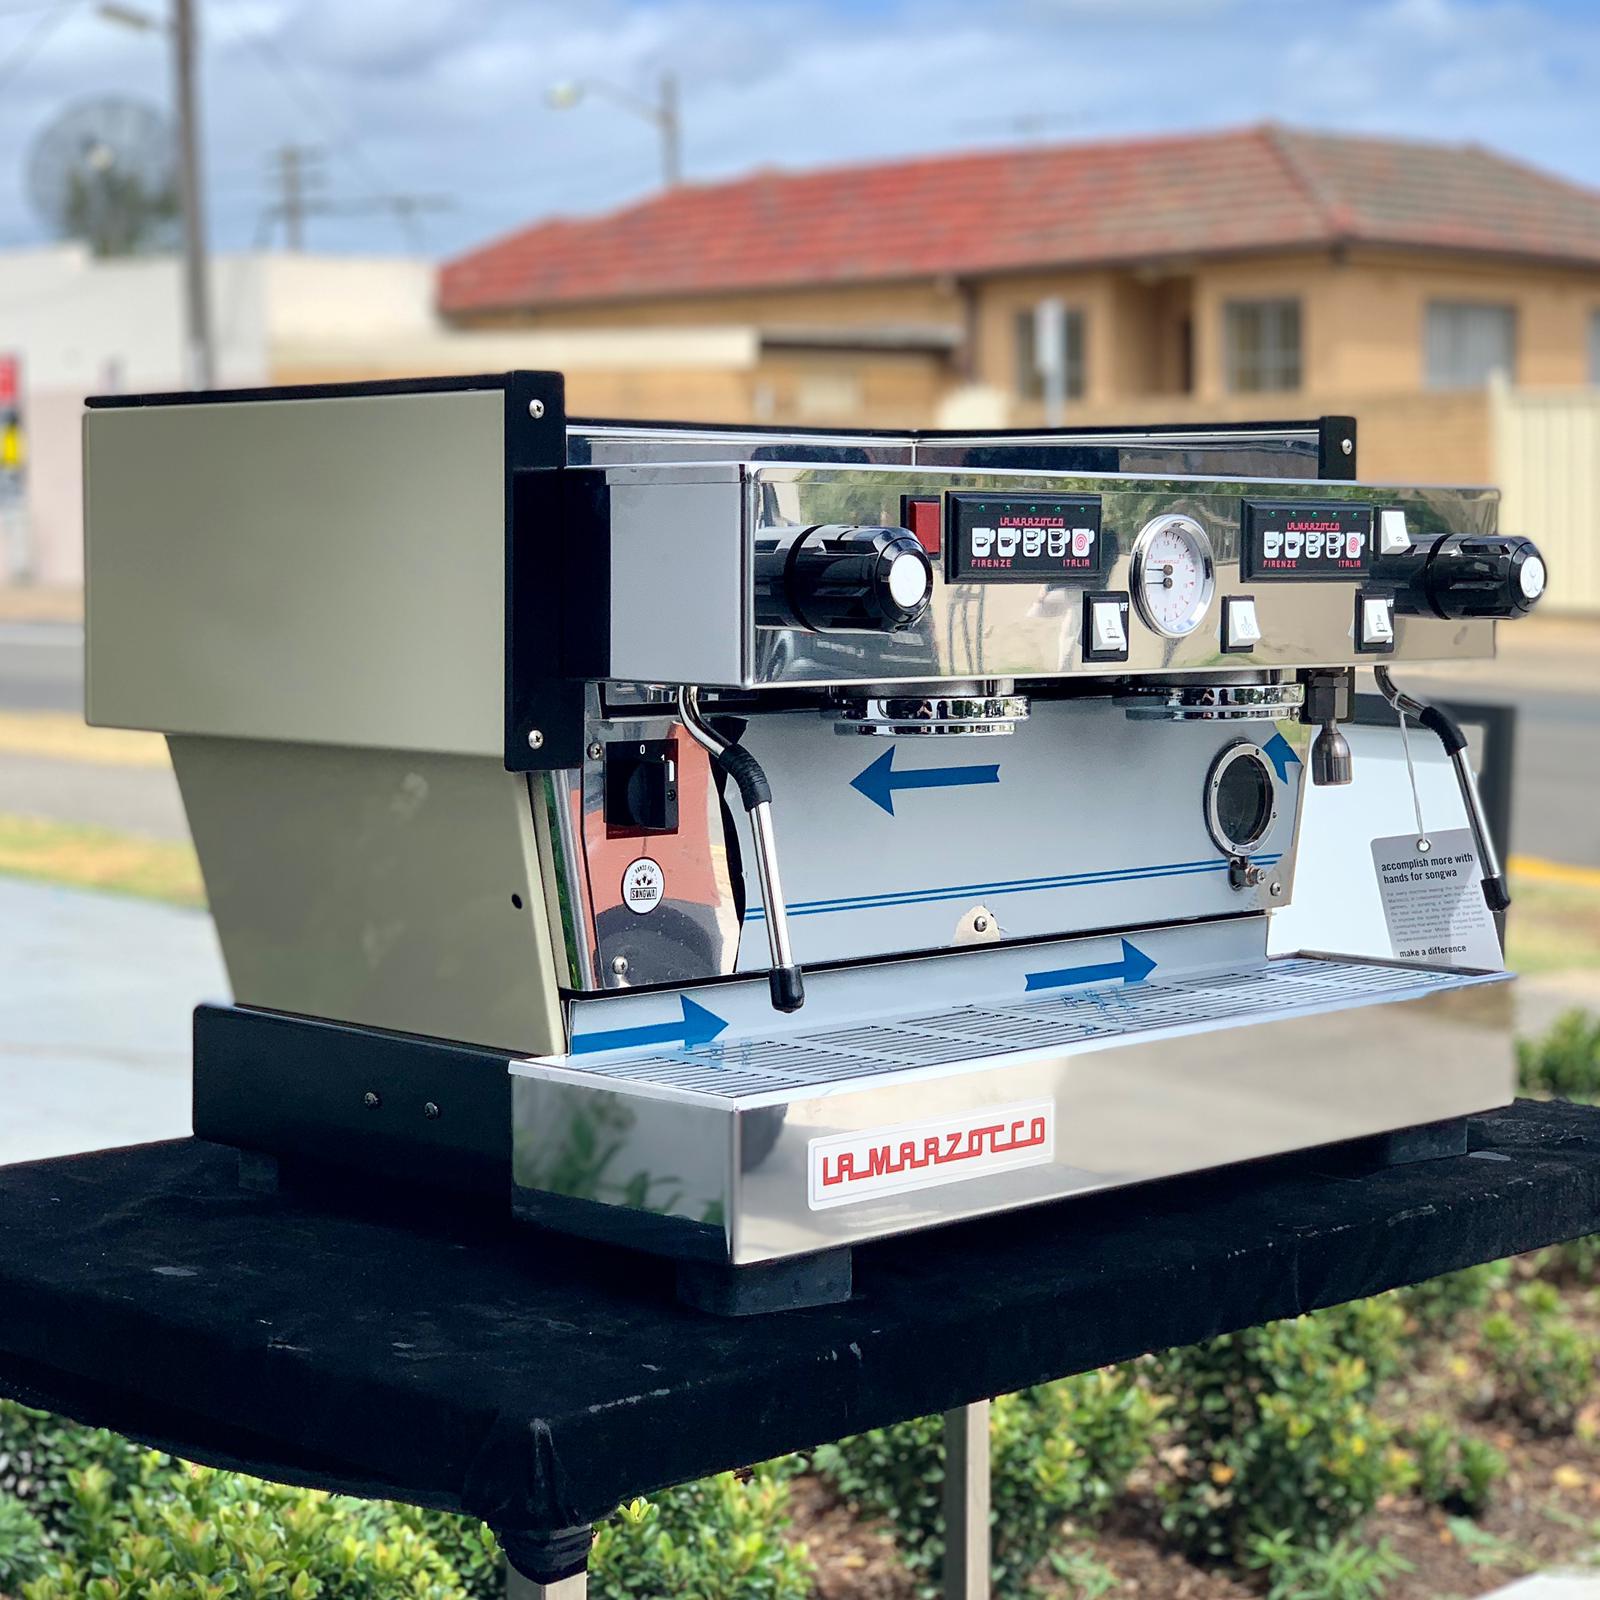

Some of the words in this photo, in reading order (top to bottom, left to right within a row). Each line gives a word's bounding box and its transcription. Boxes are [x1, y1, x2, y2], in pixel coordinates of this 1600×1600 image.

[1013, 517, 1064, 526] MARZOCCO
[971, 559, 1012, 568] FIRENZE
[1062, 560, 1090, 568] ITALIA
[1263, 560, 1297, 568] FIRENZE
[1338, 560, 1361, 568] ITALIA
[1381, 858, 1428, 871] accomplish
[1430, 856, 1453, 866] more
[1454, 853, 1473, 863] with
[1383, 873, 1409, 884] hands
[1411, 871, 1423, 881] for
[1425, 869, 1457, 880] songwa
[1399, 949, 1420, 958] make
[1427, 945, 1467, 955] difference
[822, 1152, 853, 1187] LA
[869, 1116, 1046, 1176] MARZOCCO
